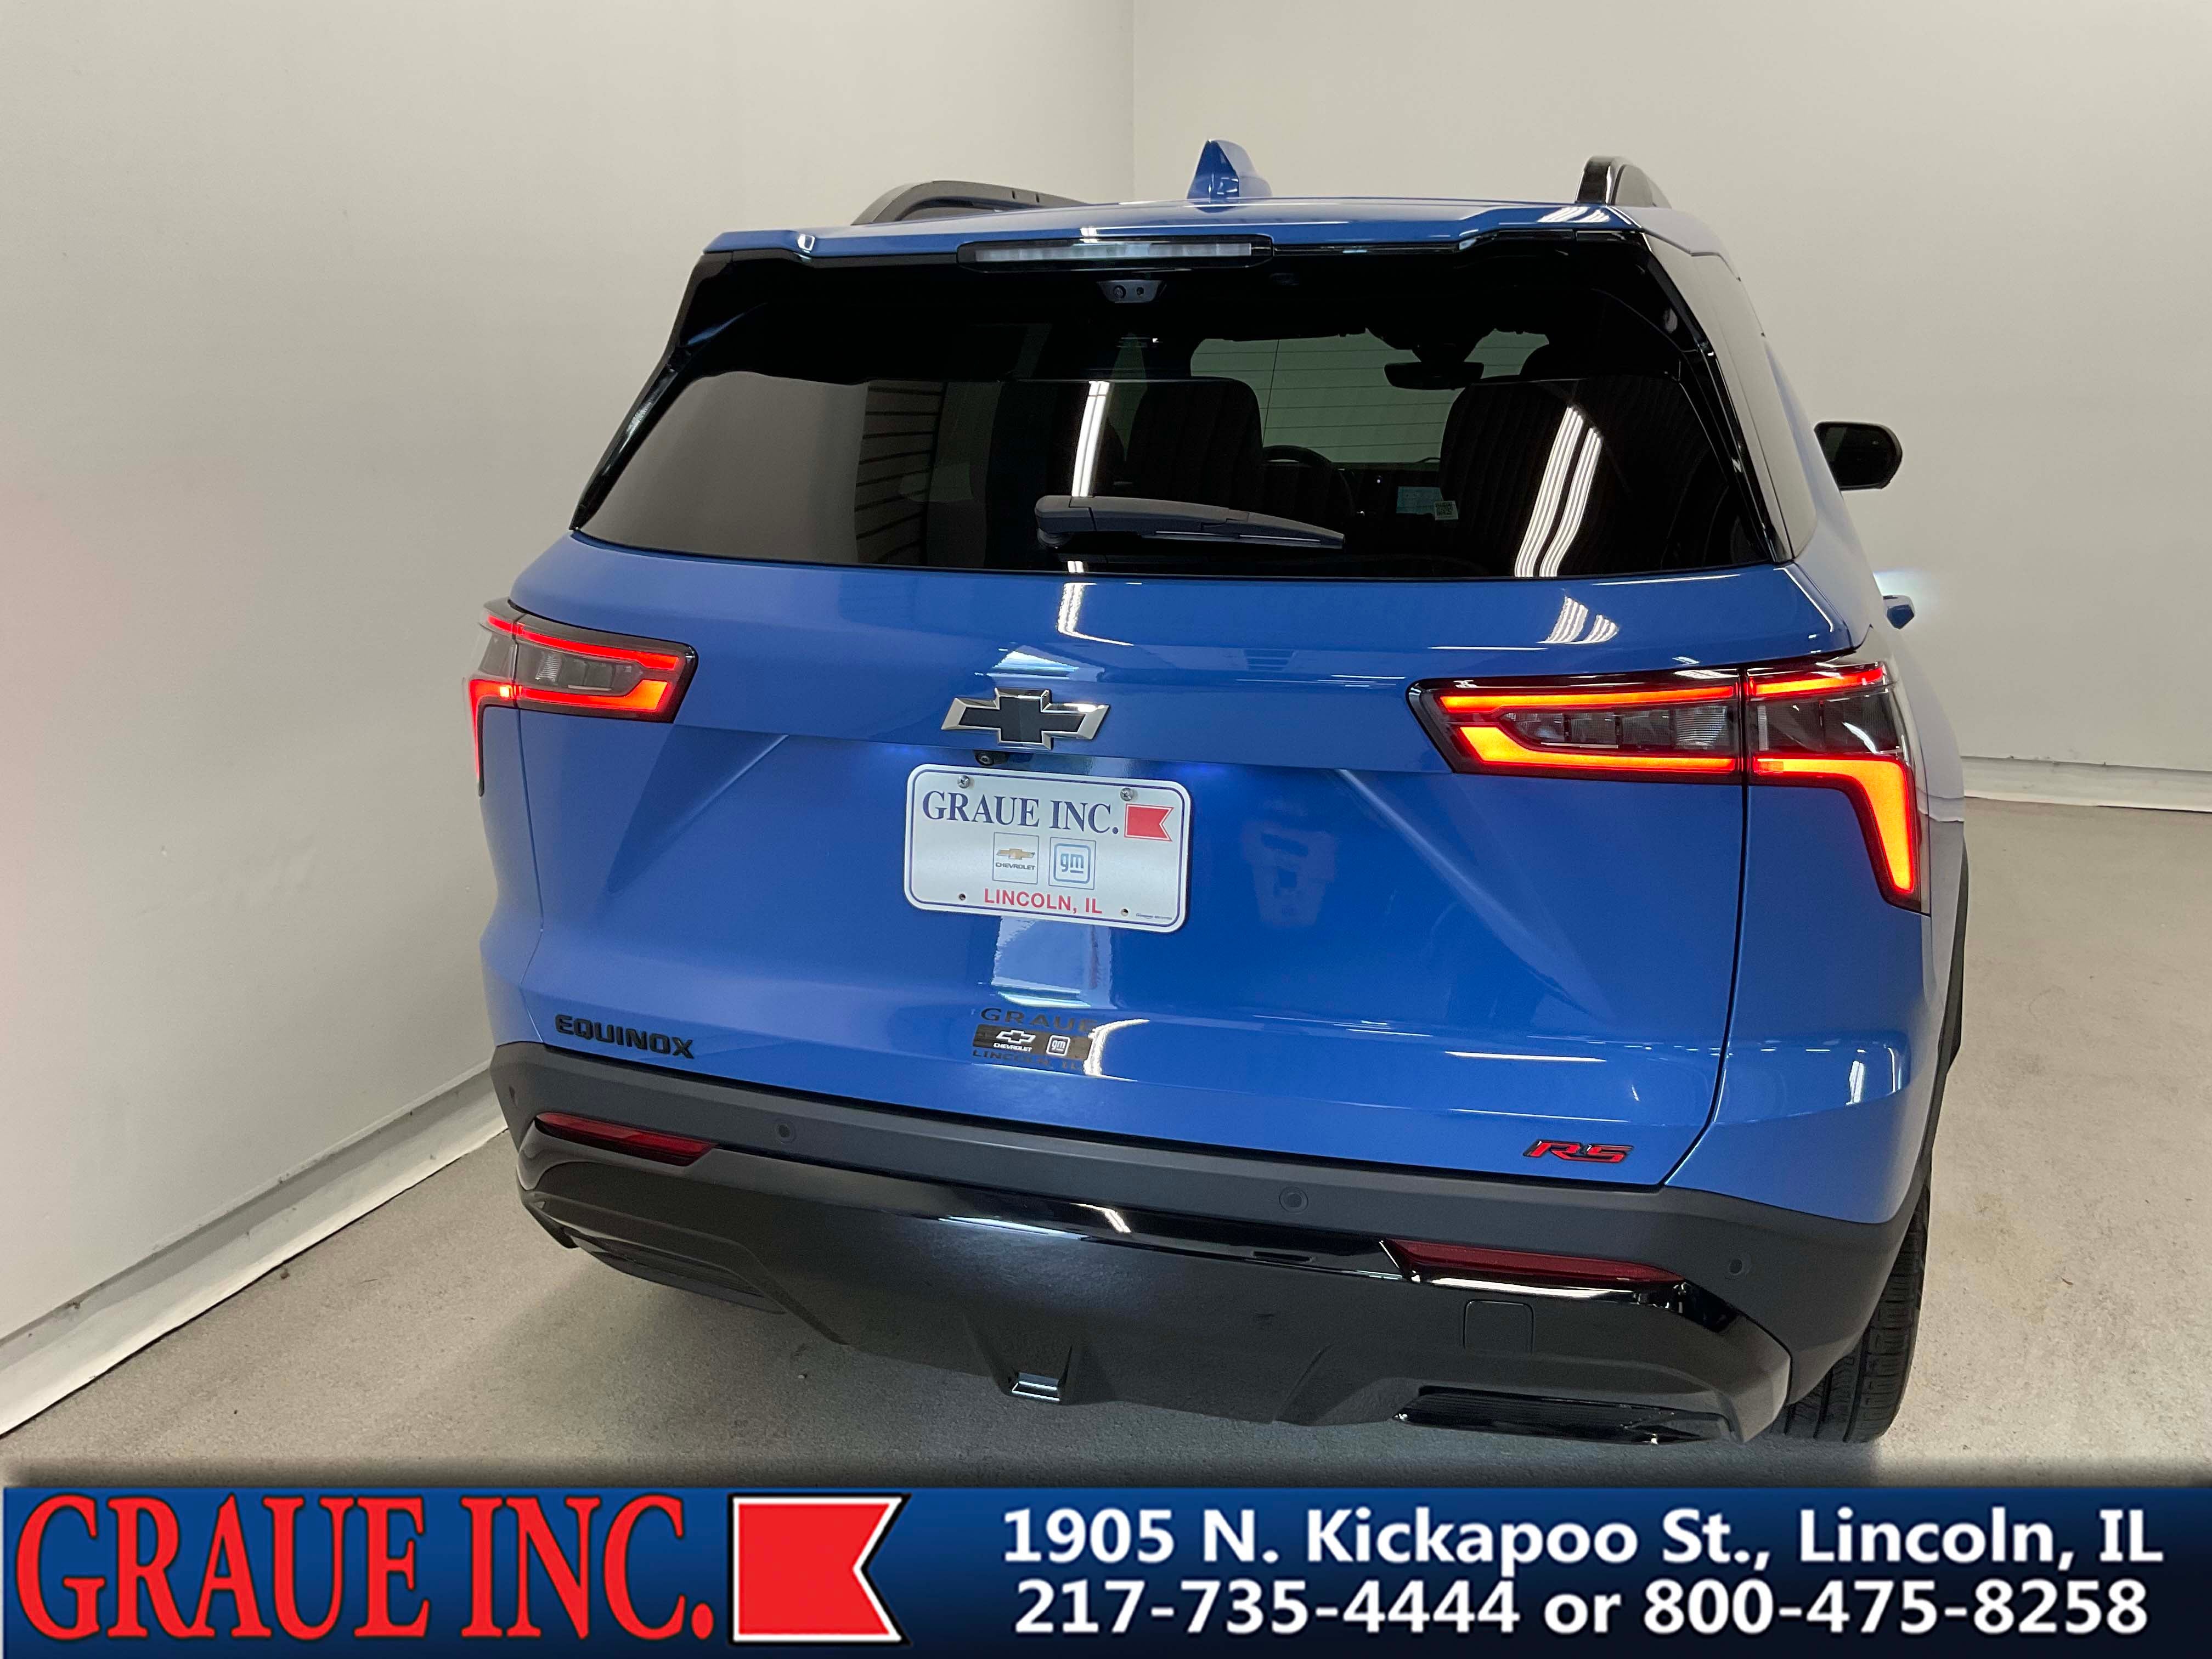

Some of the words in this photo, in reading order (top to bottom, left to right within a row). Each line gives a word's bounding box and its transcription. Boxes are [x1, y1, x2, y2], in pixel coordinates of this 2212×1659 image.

[923, 791, 1040, 827] GRAUE
[1049, 800, 1119, 835] INC.
[995, 862, 1035, 870] CHEVROLET
[1060, 854, 1084, 872] gm
[984, 888, 1078, 913] LINCOLN,
[1085, 897, 1103, 915] IL
[555, 1014, 694, 1059] EQUINOX
[1051, 1039, 1065, 1052] gm
[993, 1042, 1032, 1053] CHEVROLET
[1523, 1139, 1634, 1164] RS
